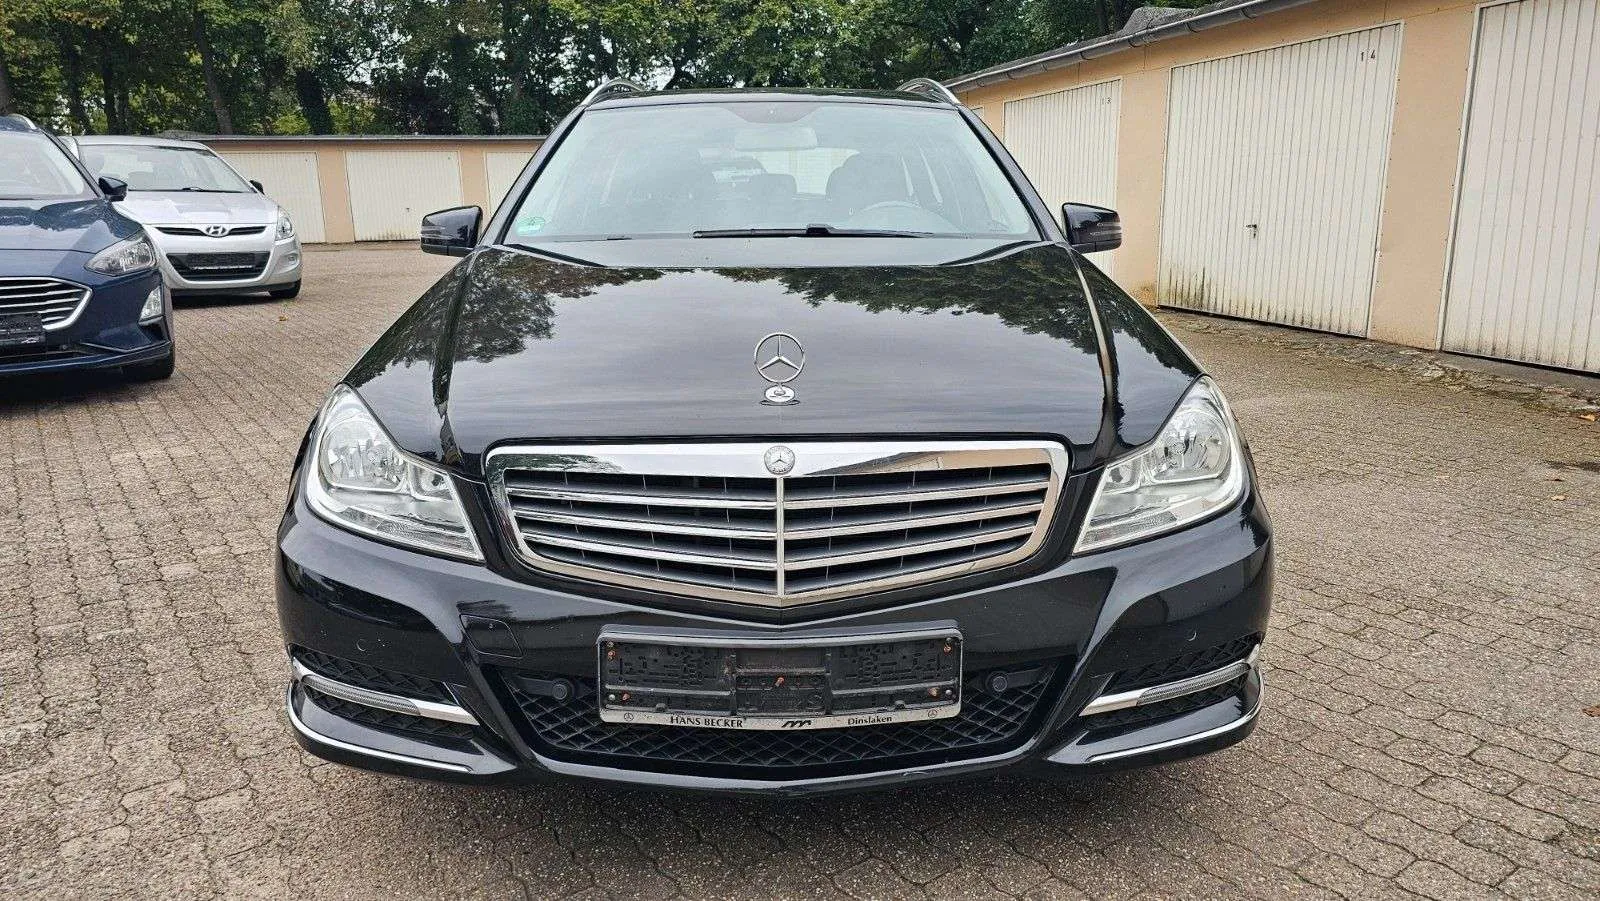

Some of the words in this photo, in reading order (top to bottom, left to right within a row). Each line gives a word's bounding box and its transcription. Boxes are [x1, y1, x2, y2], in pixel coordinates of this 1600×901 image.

[670, 715, 701, 726] HANS
[704, 716, 743, 728] BECKER
[847, 715, 893, 726] Dinslaken
